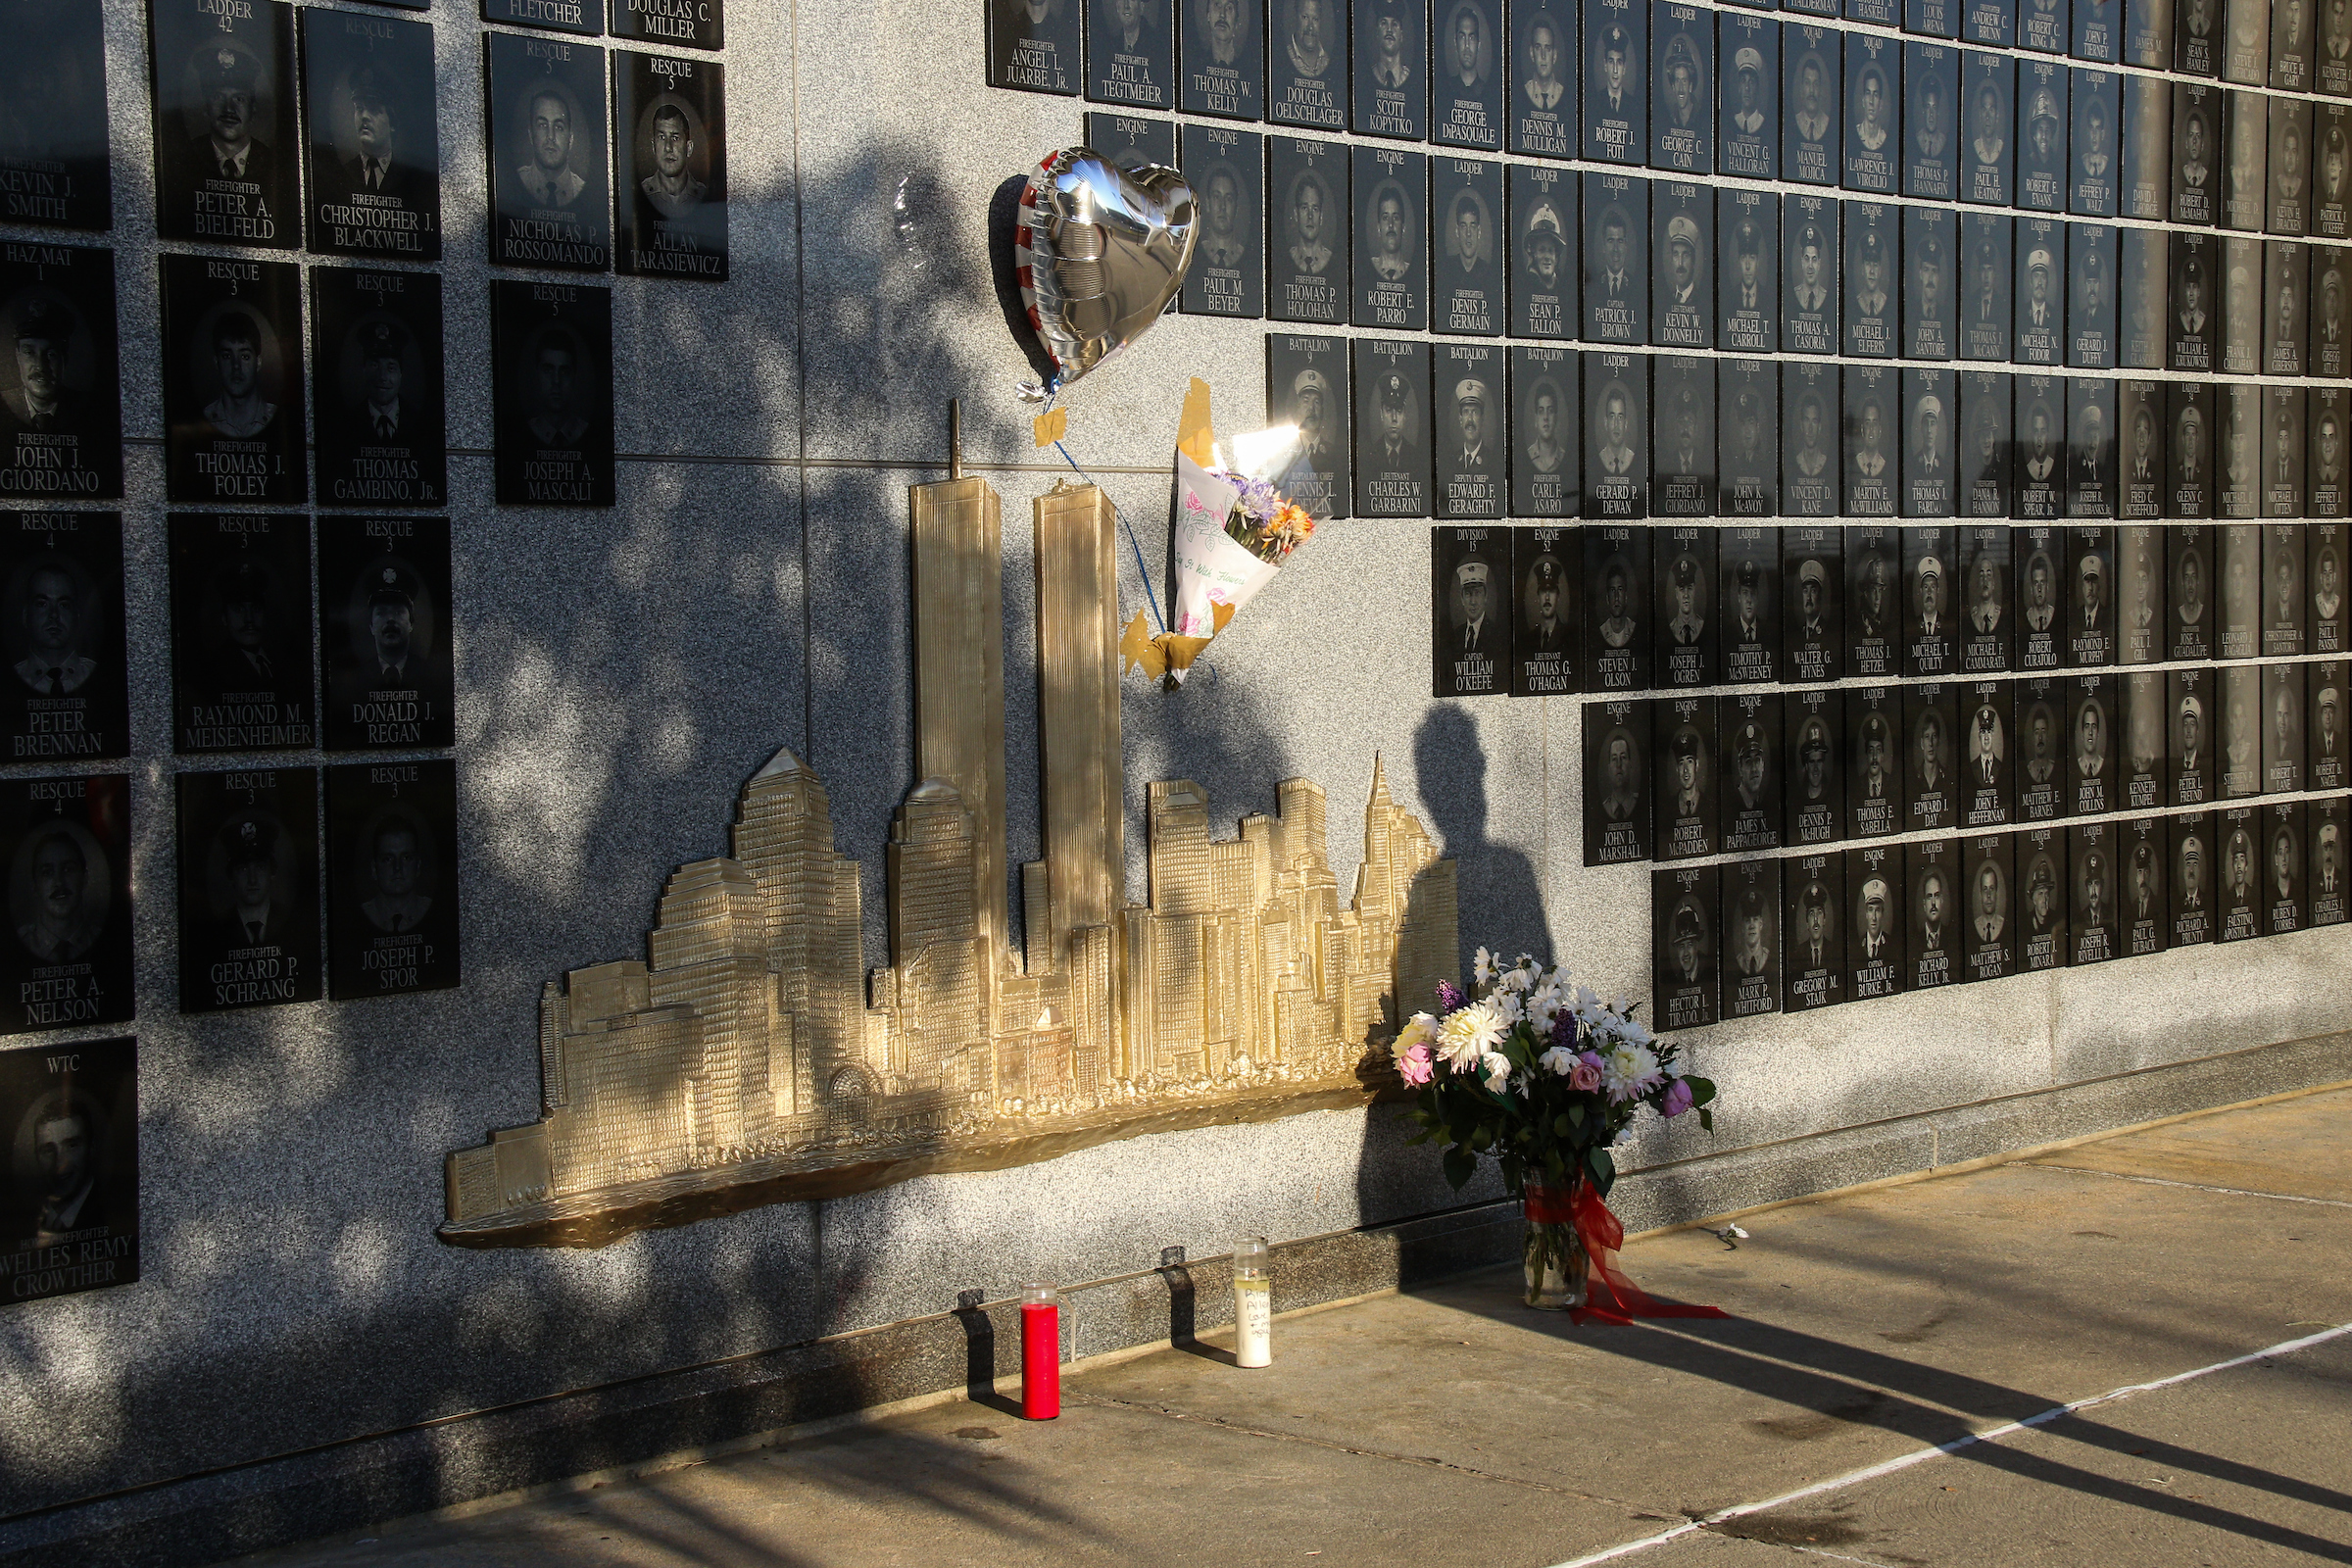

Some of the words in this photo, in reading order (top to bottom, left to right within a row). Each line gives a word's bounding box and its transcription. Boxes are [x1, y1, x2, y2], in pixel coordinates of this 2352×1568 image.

[197, 0, 253, 20] LADDER
[510, 0, 582, 25] FLETCHER
[628, 0, 693, 19] DOUGLAS
[699, 3, 711, 22] C.
[219, 17, 232, 33] 42
[646, 15, 696, 40] MILLER
[526, 40, 570, 62] RESCUE
[546, 60, 553, 74] 5
[650, 58, 692, 78] RESCUE
[1011, 49, 1049, 70] ANGEL
[1054, 55, 1064, 72] L.
[668, 75, 675, 91] 5
[1006, 66, 1051, 88] JUARBE,
[1111, 64, 1137, 82] PAUL
[1142, 70, 1152, 84] A.
[1102, 79, 1161, 103] TEGTMEIER
[1194, 74, 1236, 95] THOMAS
[1240, 81, 1251, 98] W.
[1206, 95, 1239, 113] KELLY
[1286, 87, 1332, 107] DOUGLAS
[1275, 103, 1344, 125] OELSCHLAGER
[1376, 100, 1405, 116] SCOTT
[1116, 119, 1148, 134] ENGINE
[1370, 115, 1412, 134] KOPYTKO
[1207, 129, 1238, 145] ENGINE
[1220, 143, 1226, 156] 6
[1796, 150, 1826, 167] MANUEL
[4, 157, 66, 174] FIREFIGHTER
[1798, 165, 1825, 180] MOJICA
[0, 170, 54, 194] KEVIN
[64, 176, 76, 198] J.
[206, 178, 261, 195] FIREFIGHTER
[8, 198, 67, 220] SMITH
[195, 190, 246, 215] PETER
[257, 196, 271, 217] A.
[351, 193, 403, 209] FIREFIGHTER
[319, 203, 417, 229] CHRISTOPHER
[423, 211, 433, 231] J.
[530, 209, 576, 222] FIREFIGHTER
[195, 213, 275, 240] BIELFELD
[509, 219, 580, 243] NICHOLAS
[585, 225, 597, 244] P.
[333, 226, 422, 252] BLACKWELL
[653, 231, 698, 253] ALLAN
[6, 243, 38, 264] HAZ
[41, 247, 74, 267] MAT
[505, 239, 605, 266] ROSSOMANDO
[207, 261, 259, 281] RESCUE
[630, 250, 721, 274] TARASIEWICZ
[38, 264, 44, 280] 1
[231, 280, 238, 296] 3
[356, 273, 404, 293] RESCUE
[1203, 276, 1228, 294] PAUL
[1233, 280, 1245, 296] M.
[377, 291, 384, 308] 3
[533, 284, 576, 304] RESCUE
[553, 302, 559, 317] 5
[1207, 294, 1241, 313] BEYER
[1376, 307, 1406, 323] PARRO
[1595, 309, 1627, 323] PATRICK
[1630, 311, 1636, 324] J.
[1601, 322, 1630, 338] BROWN
[1663, 327, 1703, 344] DONNELLY
[1373, 341, 1413, 355] BATTALION
[1450, 347, 1488, 361] BATTALION
[1392, 354, 1396, 366] 9
[1467, 360, 1472, 370] 9
[2082, 351, 2102, 364] DUFFY
[18, 432, 78, 446] FIREFIGHTER
[213, 440, 268, 453] FIREFIGHTER
[15, 446, 64, 469] JOHN
[72, 448, 83, 468] J.
[360, 446, 410, 459] FIREFIGHTER
[536, 449, 582, 462] FIREFIGHTER
[195, 452, 267, 474] THOMAS
[274, 456, 285, 474] J.
[353, 458, 418, 480] THOMAS
[524, 461, 574, 482] JOSEPH
[582, 464, 595, 482] A.
[0, 467, 99, 492] GIORDANO
[214, 474, 267, 497] FOLEY
[1368, 481, 1409, 496] CHARLES
[1411, 482, 1421, 496] W.
[333, 478, 413, 502] GAMBINO,
[528, 481, 592, 502] MASCALI
[1448, 484, 1486, 498] EDWARD
[1489, 485, 1495, 498] F.
[1370, 497, 1421, 512] GARBARINI
[1448, 498, 1496, 514] GERAGHTY
[21, 514, 78, 531] RESCUE
[219, 515, 270, 534] RESCUE
[366, 520, 414, 537] RESCUE
[47, 532, 55, 549] 4
[241, 532, 249, 549] 3
[387, 536, 394, 552] 3
[1196, 564, 1212, 577] With
[1217, 570, 1246, 585] Flowers
[1454, 660, 1494, 675] WILLIAM
[1524, 661, 1559, 676] THOMAS
[1562, 660, 1571, 674] G.
[1455, 674, 1493, 691] O'KEEFE
[1529, 675, 1568, 691] O'HAGAN
[27, 698, 87, 710] FIREFIGHTER
[221, 691, 275, 704] FIREFIGHTER
[368, 690, 418, 702] FIREFIGHTER
[29, 710, 85, 734] PETER
[192, 704, 278, 726] RAYMOND
[285, 703, 305, 724] M.
[353, 702, 417, 724] DONALD
[424, 702, 435, 721] J.
[186, 723, 312, 749] MEISENHEIMER
[368, 723, 420, 745] REGAN
[14, 733, 103, 758] BRENNAN
[225, 772, 275, 791] RESCUE
[370, 766, 418, 785] RESCUE
[29, 781, 86, 801] RESCUE
[248, 790, 255, 805] 3
[392, 783, 399, 798] 3
[55, 799, 63, 815] 4
[2029, 804, 2054, 817] BARNES
[1604, 832, 1624, 846] JOHN
[1627, 830, 1636, 844] D.
[1598, 845, 1642, 861] MARSHALL
[1668, 839, 1709, 857] McPADDEN
[373, 934, 423, 948] FIREFIGHTER
[227, 945, 282, 960] FIREFIGHTER
[362, 947, 418, 970] JOSEPH
[424, 946, 435, 963] P.
[32, 962, 92, 980] FIREFIGHTER
[211, 957, 279, 983] GERARD
[286, 956, 299, 976] P.
[380, 966, 418, 989] SPOR
[21, 979, 77, 1004] PETER
[88, 979, 104, 999] A.
[215, 978, 295, 1004] SCHRANG
[1738, 985, 1761, 1000] MARK
[1763, 984, 1770, 998] P.
[26, 999, 100, 1025] NELSON
[1735, 997, 1773, 1013] WHITFORD
[47, 1054, 80, 1073] WTC
[0, 1246, 70, 1276] WELLES
[79, 1235, 132, 1260] REMY
[13, 1261, 116, 1298] CROWTHER
